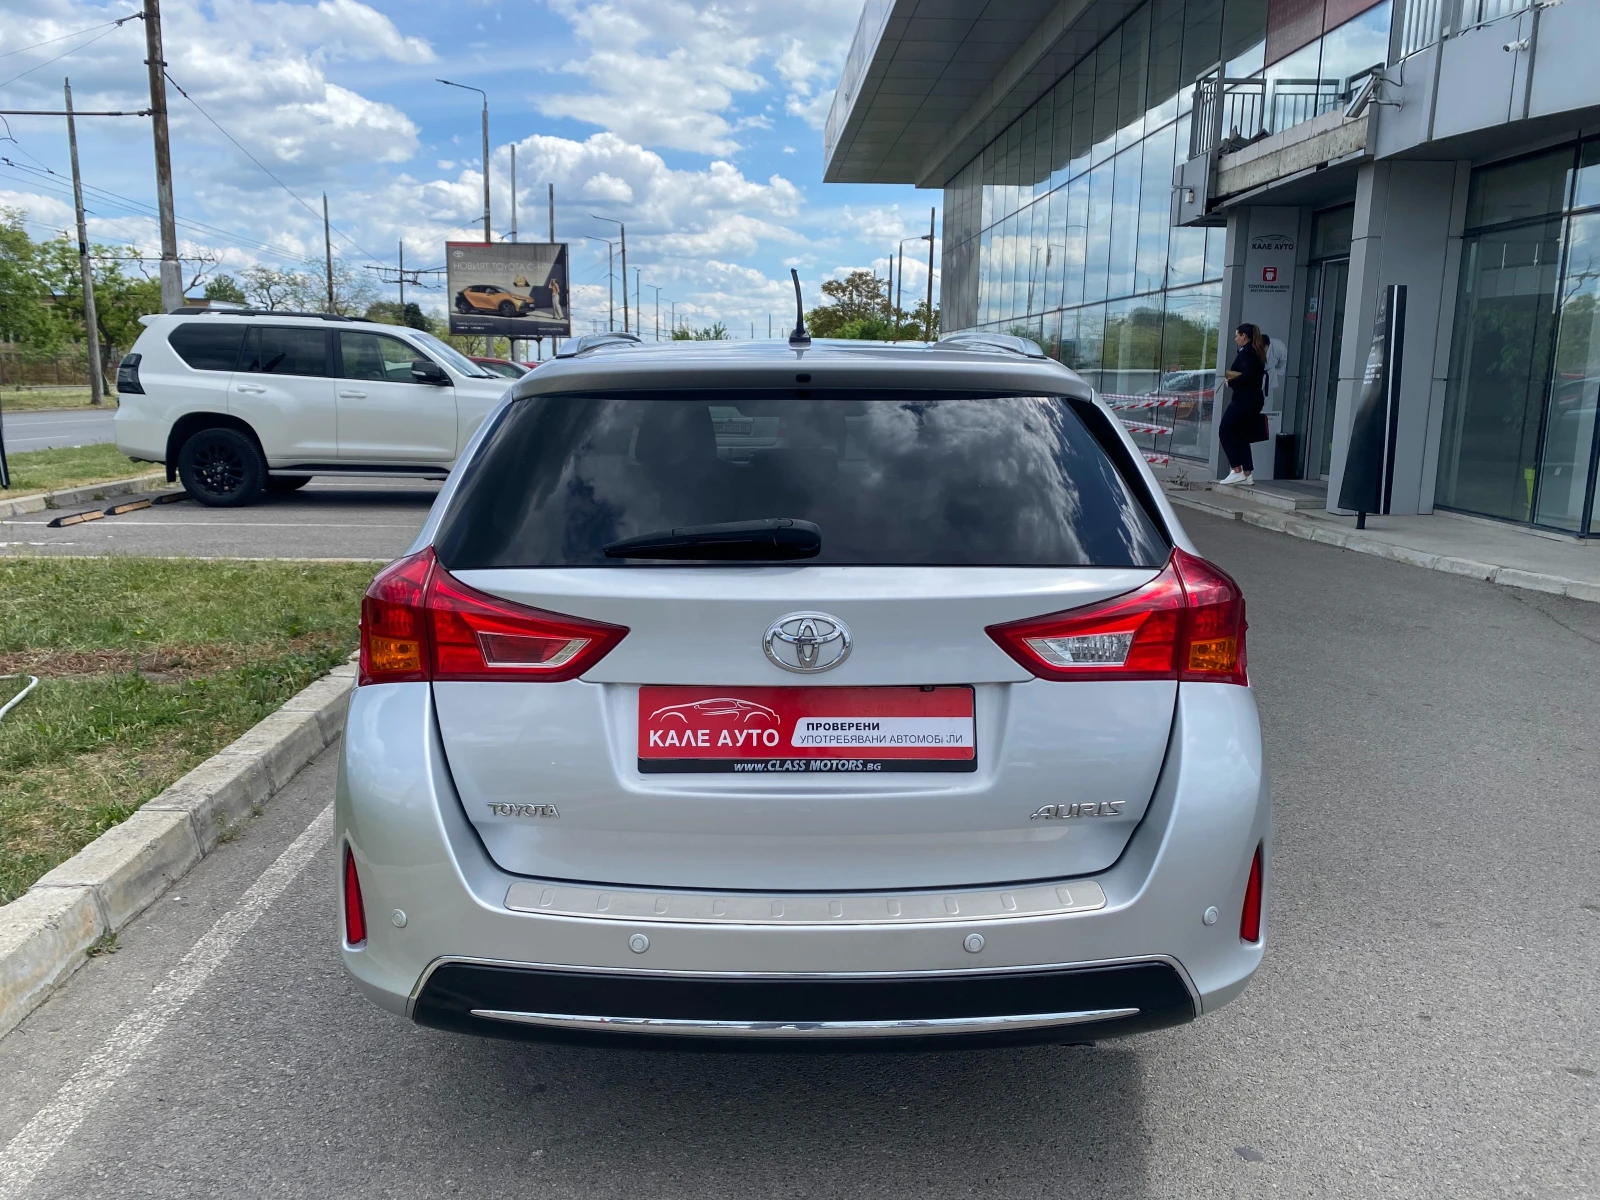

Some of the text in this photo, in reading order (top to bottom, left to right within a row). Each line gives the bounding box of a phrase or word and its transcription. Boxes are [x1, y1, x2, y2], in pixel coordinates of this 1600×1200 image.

[453, 262, 489, 270] НОВИЯТ
[492, 262, 525, 271] TOYOTA
[806, 722, 880, 731] ПРОВЕРЕНИ
[649, 729, 780, 747] КАЛЕ АУТО
[799, 734, 887, 744] УПОТРЕБЯВАНИ
[486, 801, 561, 819] TOYOTA
[1029, 799, 1126, 821] AURIS
